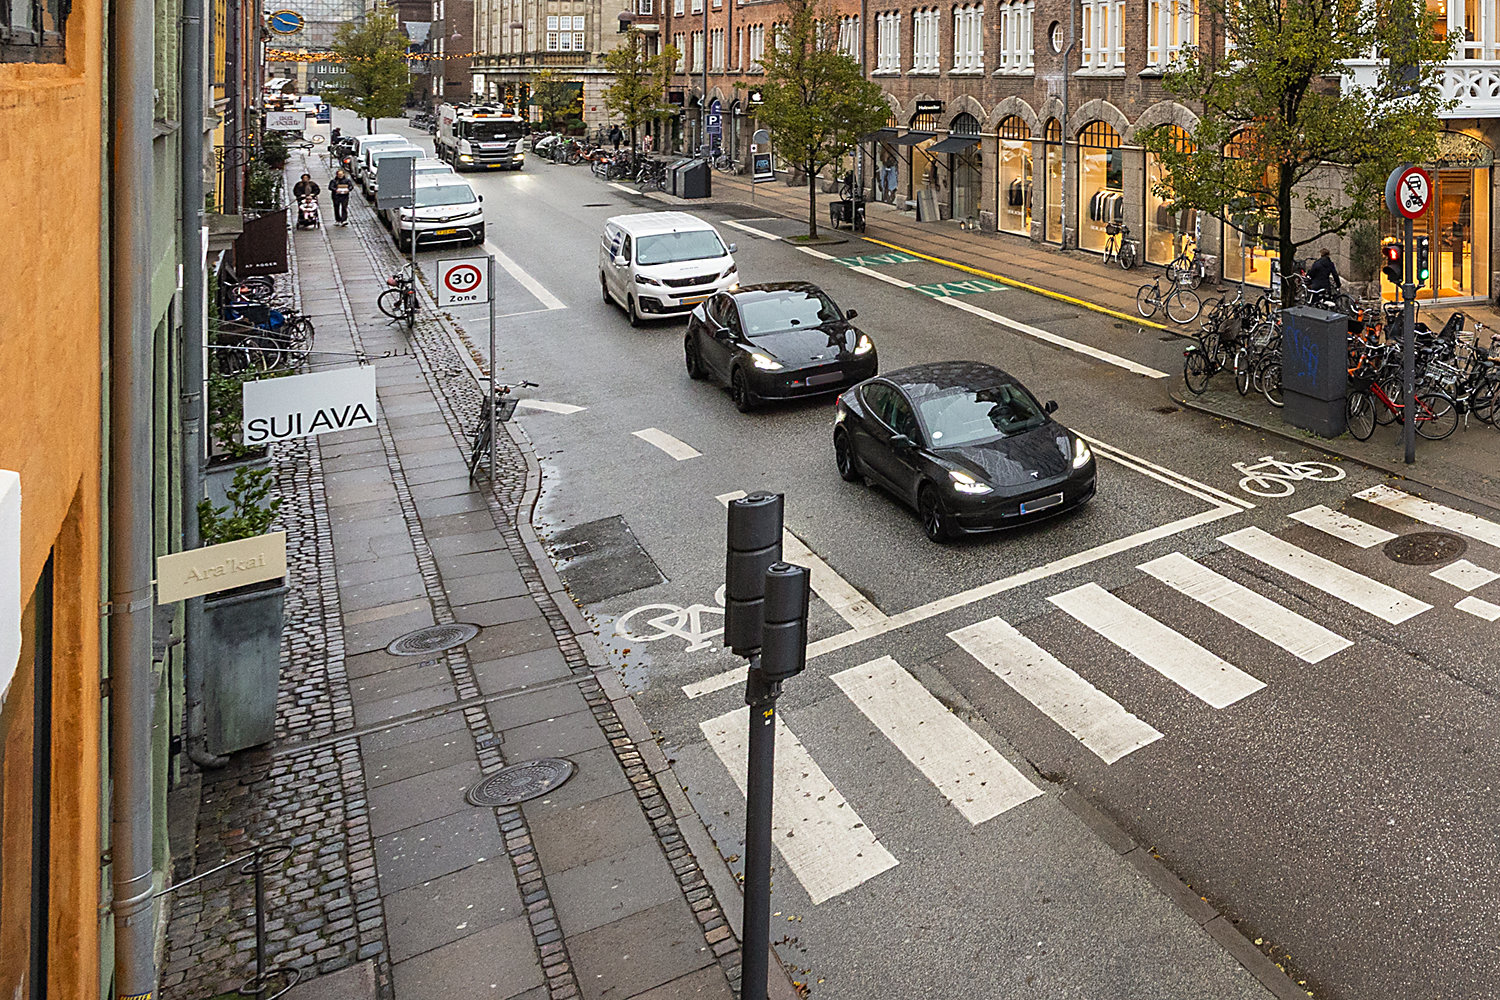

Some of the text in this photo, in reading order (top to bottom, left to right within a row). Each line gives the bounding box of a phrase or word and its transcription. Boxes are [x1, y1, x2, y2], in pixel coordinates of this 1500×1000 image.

[319, 105, 328, 113] P
[709, 116, 718, 125] P
[452, 272, 475, 285] 30
[912, 280, 1010, 298] TAXI
[449, 295, 477, 303] Zone
[308, 403, 373, 433] AVA
